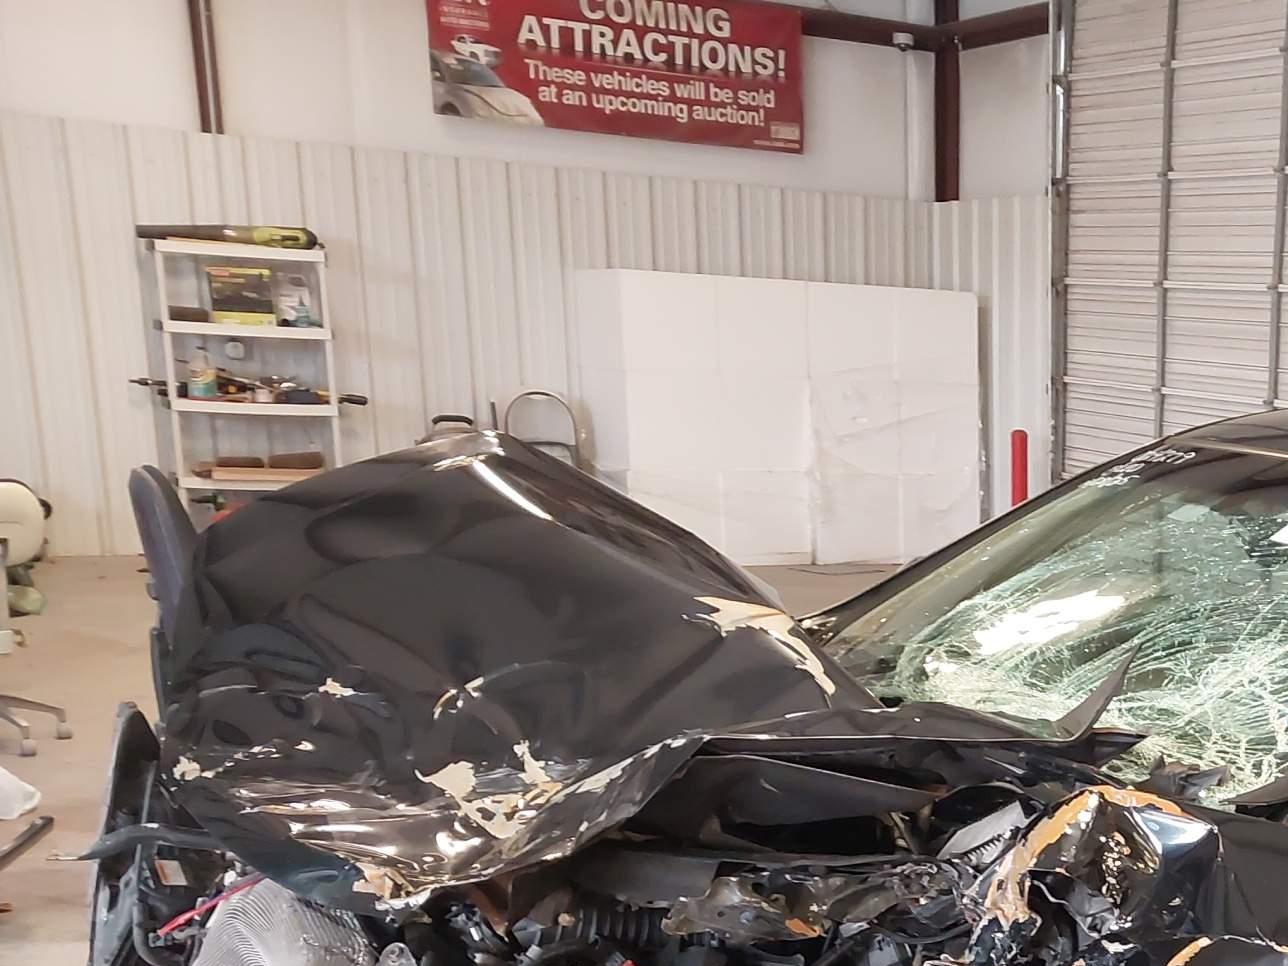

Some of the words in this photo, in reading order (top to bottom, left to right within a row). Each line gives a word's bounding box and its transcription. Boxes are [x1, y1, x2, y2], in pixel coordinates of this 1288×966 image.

[578, 0, 731, 38] COMING
[517, 15, 786, 77] ATTRACTIONS!
[524, 58, 587, 86] These
[590, 70, 671, 97] vehicles
[673, 80, 706, 101] will
[709, 82, 735, 104] be
[737, 88, 776, 109] sold
[538, 84, 559, 103] at
[561, 89, 588, 107] an
[591, 93, 689, 123] upcoming
[692, 104, 766, 127] auction!
